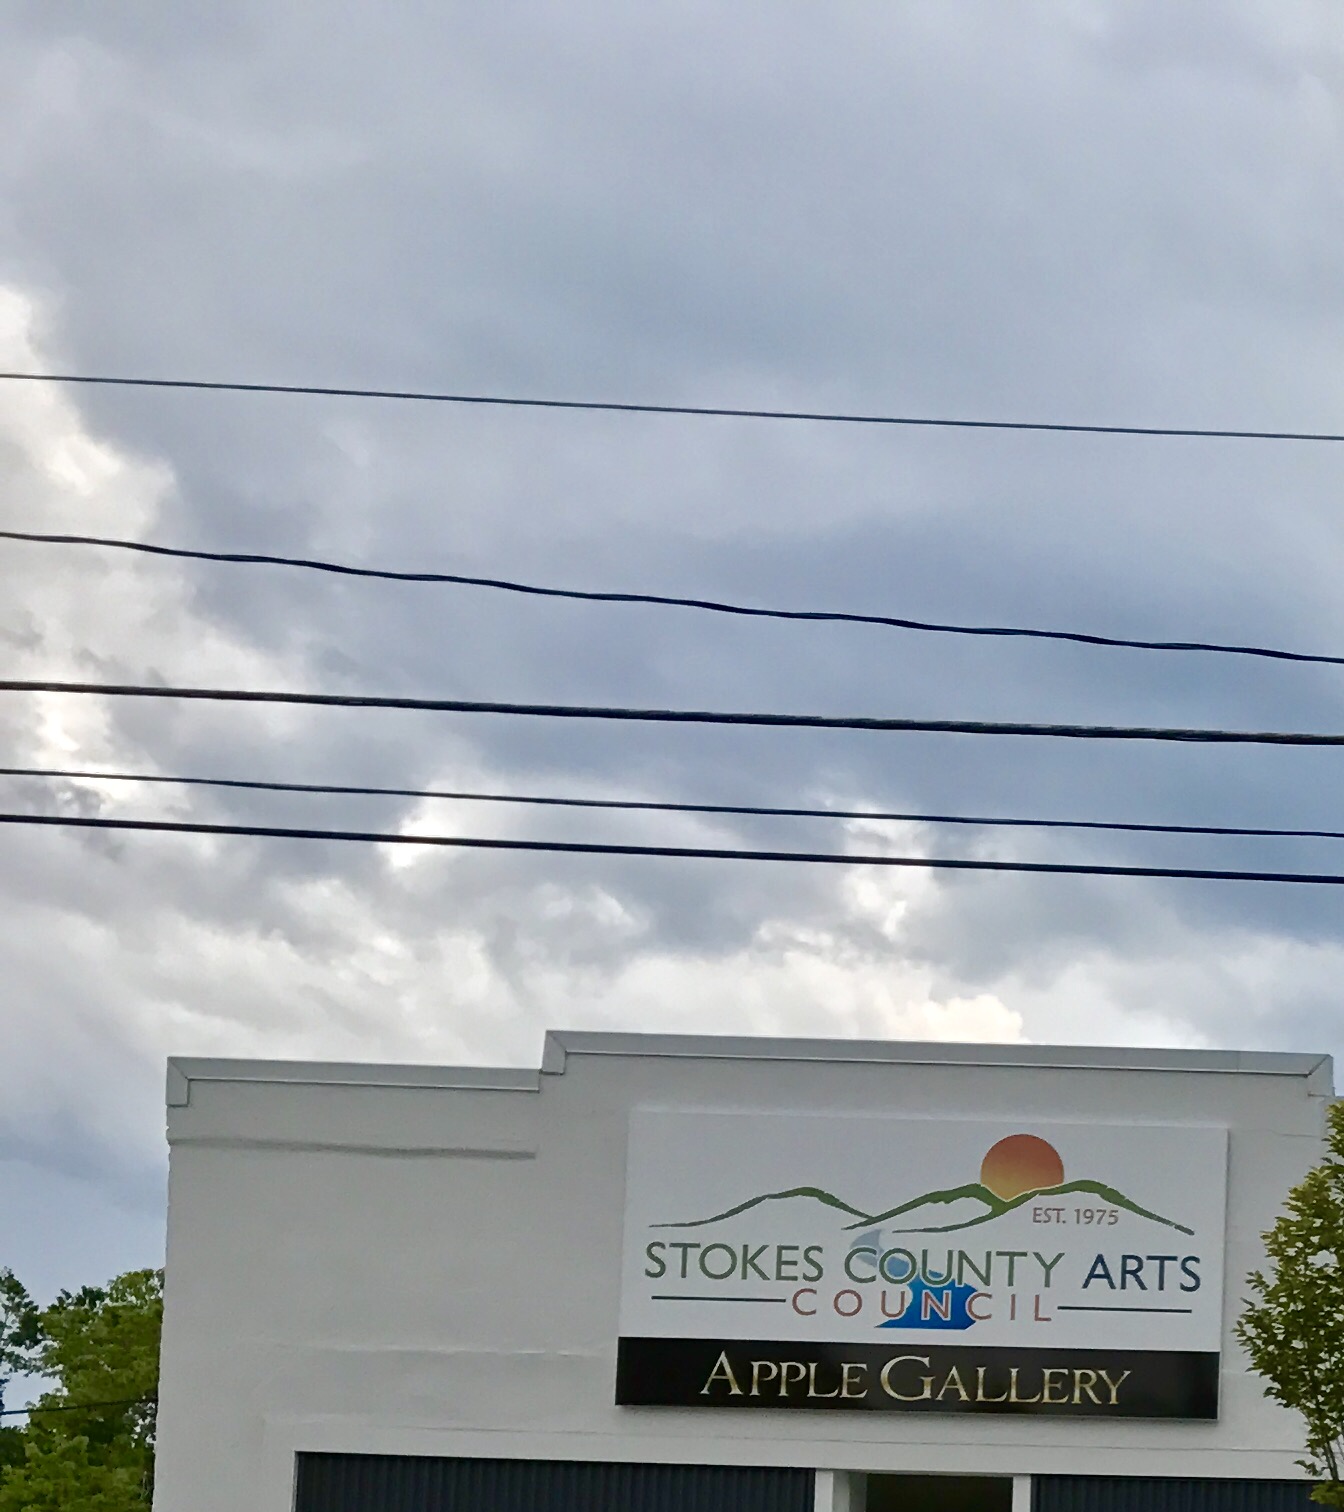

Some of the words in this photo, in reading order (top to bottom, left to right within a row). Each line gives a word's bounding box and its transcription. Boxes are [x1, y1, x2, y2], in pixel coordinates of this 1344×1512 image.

[1032, 1207, 1067, 1225] EST.
[1074, 1208, 1120, 1227] 1975
[644, 1241, 825, 1284] STOKES
[843, 1246, 1066, 1290] COUNTY
[1082, 1253, 1202, 1294] ARTS
[791, 1288, 1052, 1323] COUNCIL
[700, 1350, 869, 1400] APPLE
[880, 1355, 1132, 1407] GALLERY
